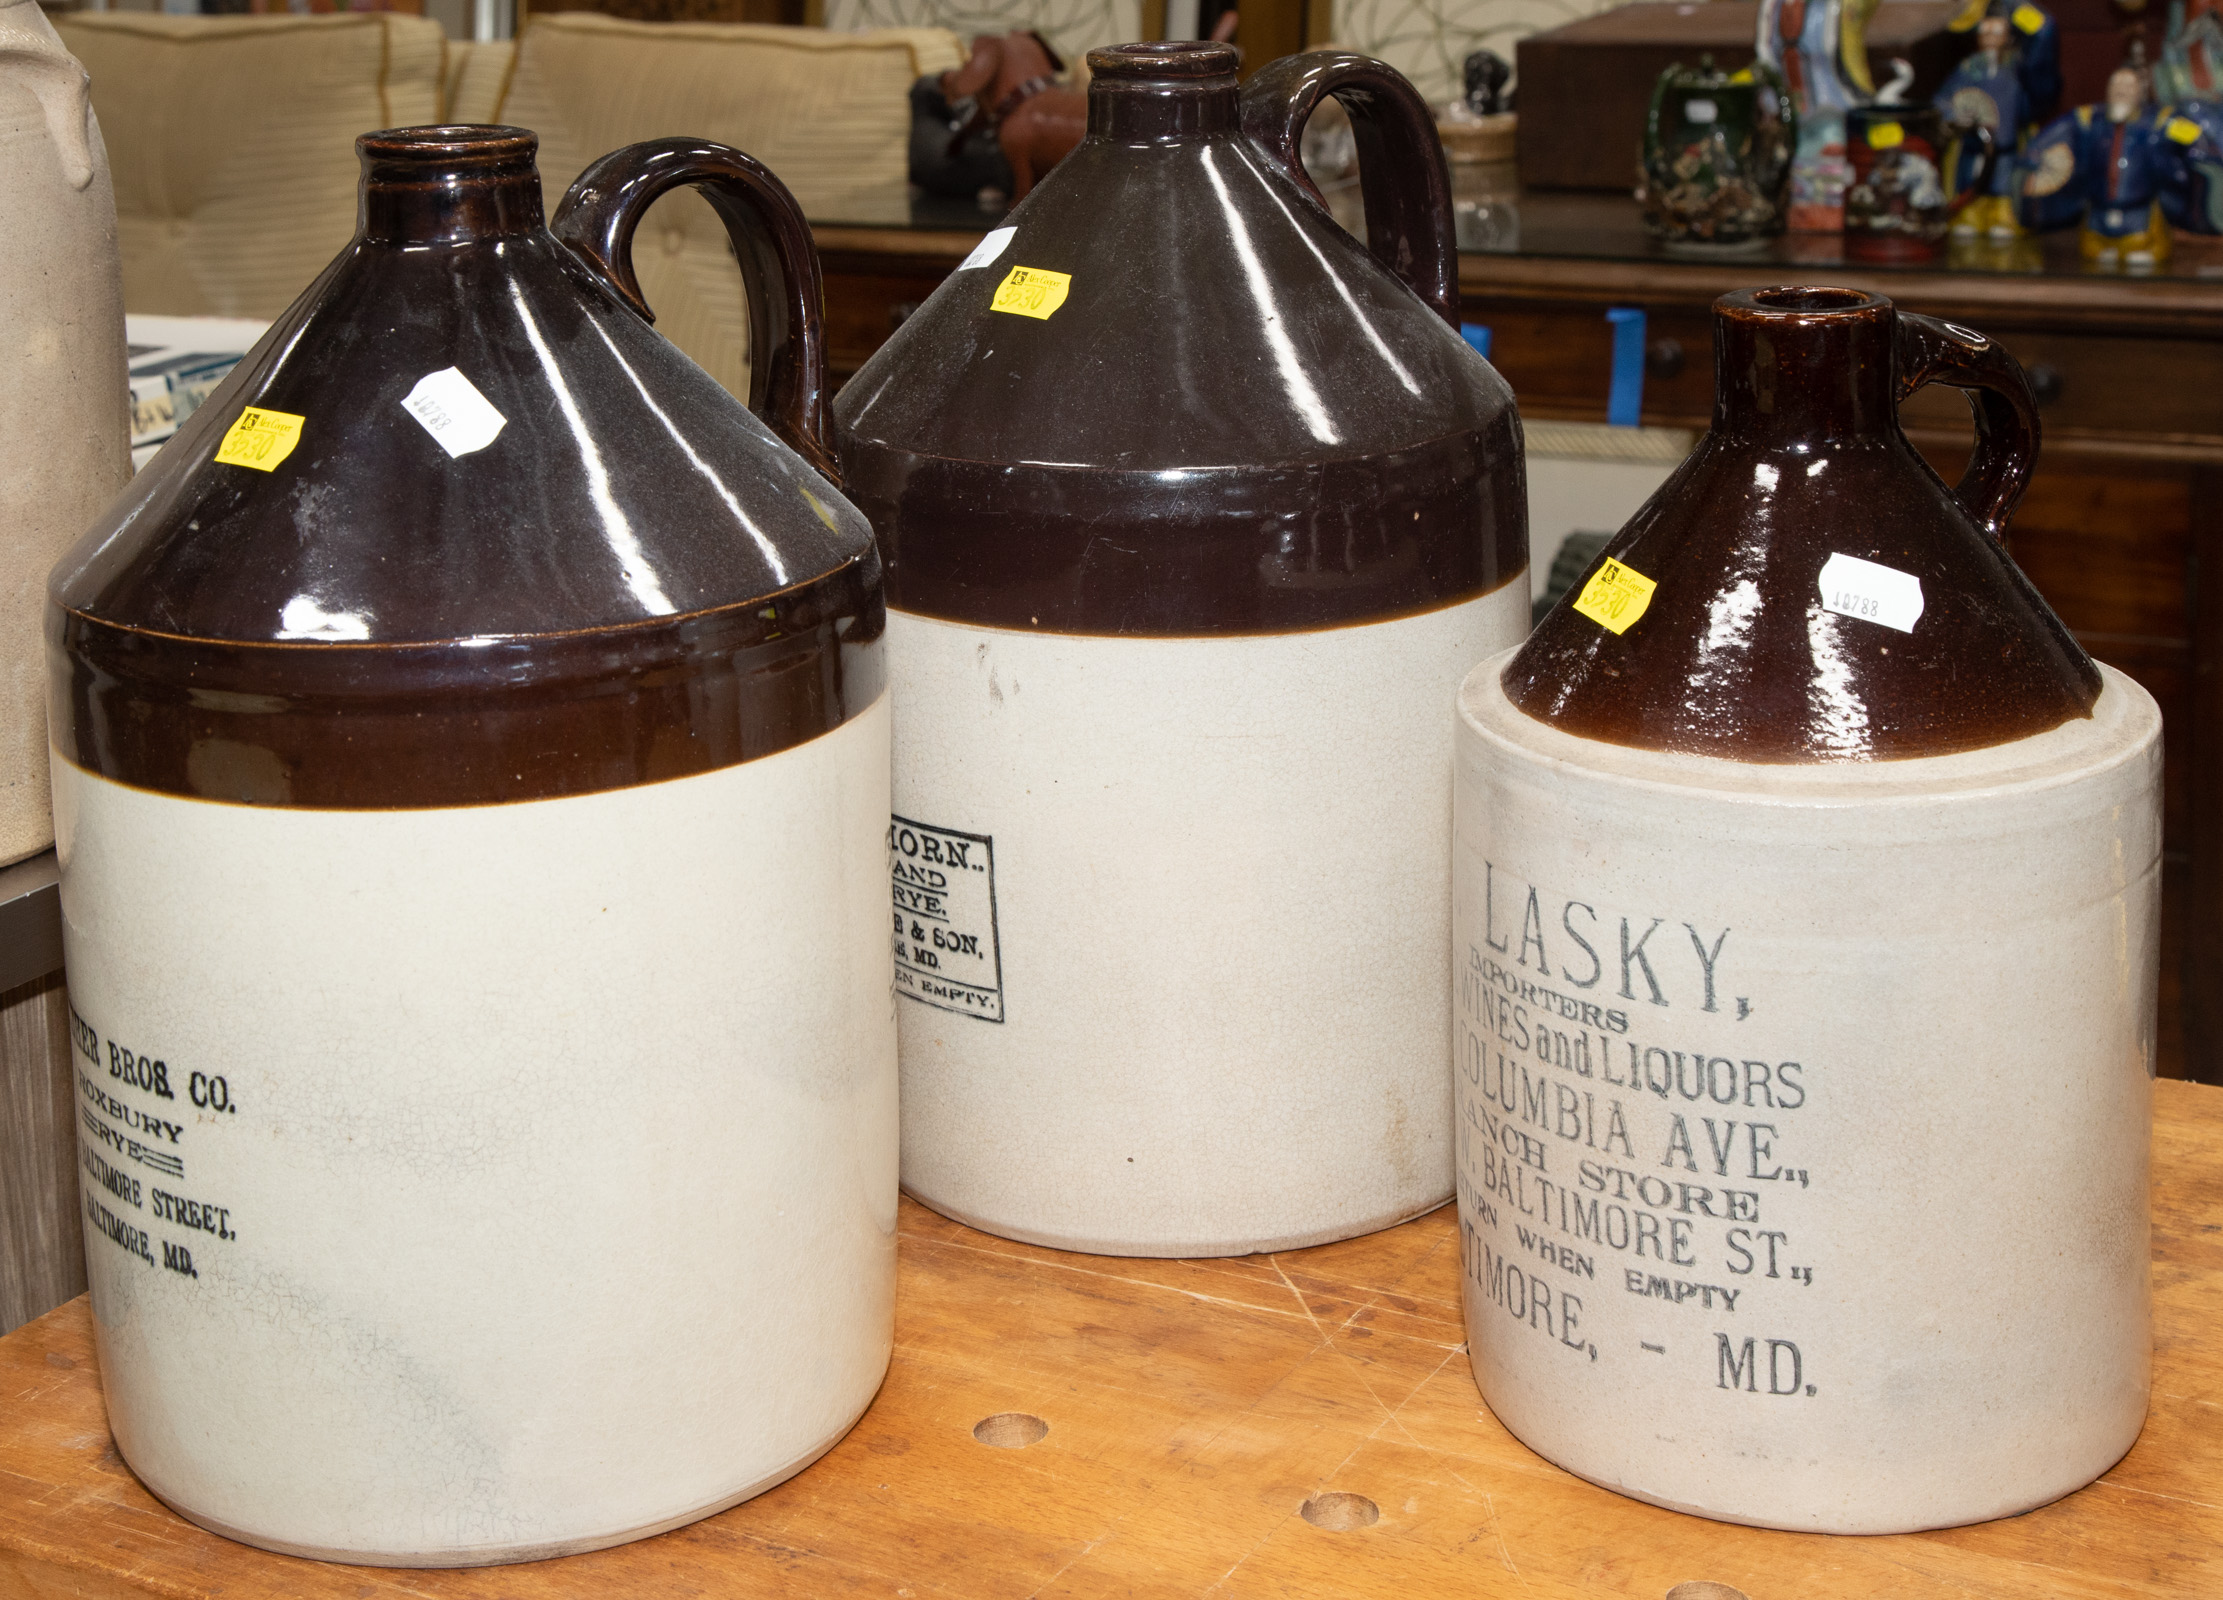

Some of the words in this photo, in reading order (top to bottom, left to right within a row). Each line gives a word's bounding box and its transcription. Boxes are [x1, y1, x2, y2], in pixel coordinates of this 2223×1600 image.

[1833, 590, 1879, 617] 10788
[893, 860, 947, 889] AND
[893, 884, 947, 916] RYE.
[911, 920, 925, 942] &
[933, 927, 983, 960] SON,
[914, 946, 941, 971] MD.
[1484, 860, 1754, 1020] LASKY,
[922, 980, 995, 1009] EMPTY.
[1536, 1020, 1592, 1079] and
[1599, 1041, 1806, 1110] LIQUORS
[78, 1066, 183, 1143] ROXBURY
[189, 1071, 236, 1114] CO.
[98, 1120, 143, 1163] RYE
[1484, 1144, 1698, 1269] BALTIMORE
[1578, 1158, 1761, 1224] STORE
[152, 1188, 236, 1241] STREET,
[162, 1241, 198, 1279] MD.
[1515, 1223, 1596, 1282] WHEN
[1624, 1268, 1742, 1313] EMPTY
[1714, 1331, 1817, 1397] MD.
